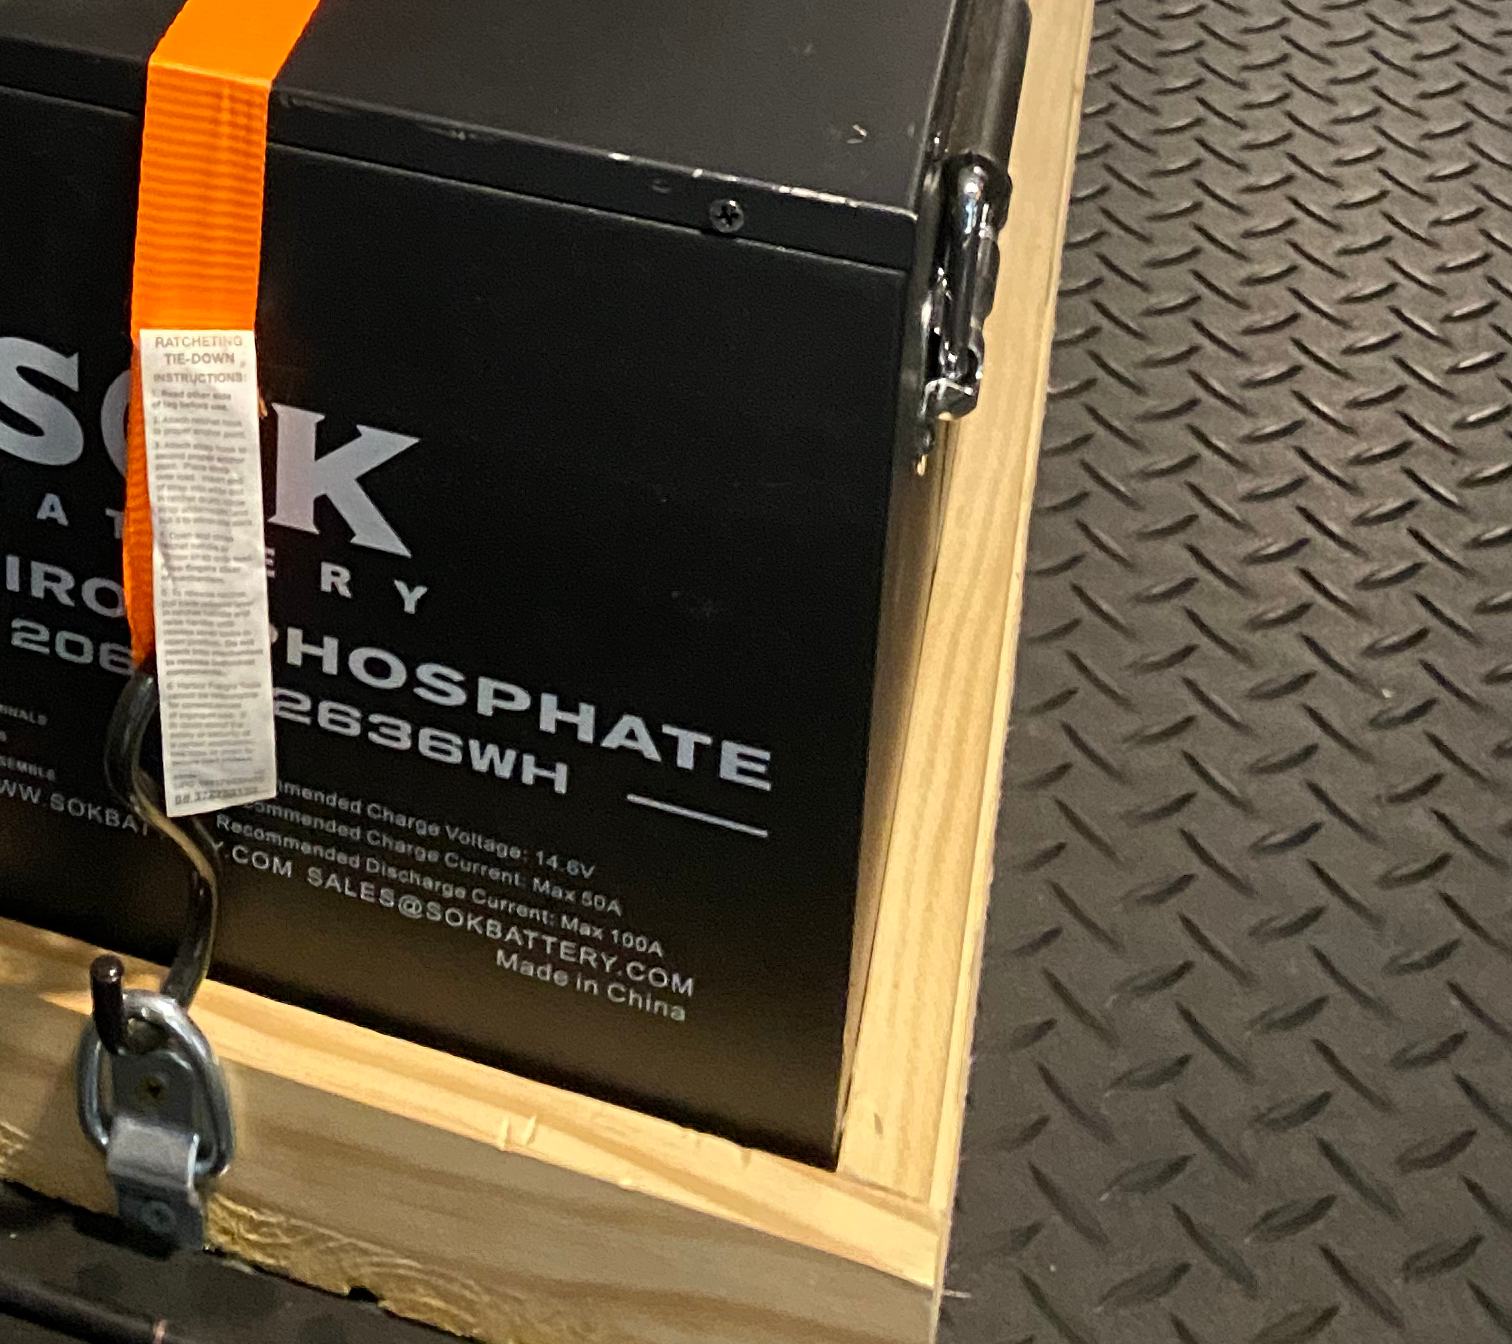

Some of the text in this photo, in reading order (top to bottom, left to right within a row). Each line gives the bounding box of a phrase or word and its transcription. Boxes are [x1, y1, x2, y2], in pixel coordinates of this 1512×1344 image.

[155, 334, 243, 349] RATCHETING
[164, 352, 236, 366] TIE-DOWN
[5, 553, 126, 619] IRO
[270, 624, 773, 792] HOSPHATE
[273, 686, 569, 795] 2636WH
[366, 802, 441, 837] Charge
[216, 813, 361, 869] Recommended
[365, 857, 467, 900] Discharge
[561, 914, 604, 941] Max
[611, 928, 664, 958] 100A
[366, 829, 440, 863] Charge
[532, 876, 576, 903] Max
[306, 865, 695, 998] SALES@SOKBATTERY.COM
[496, 948, 686, 1022] Made in China
